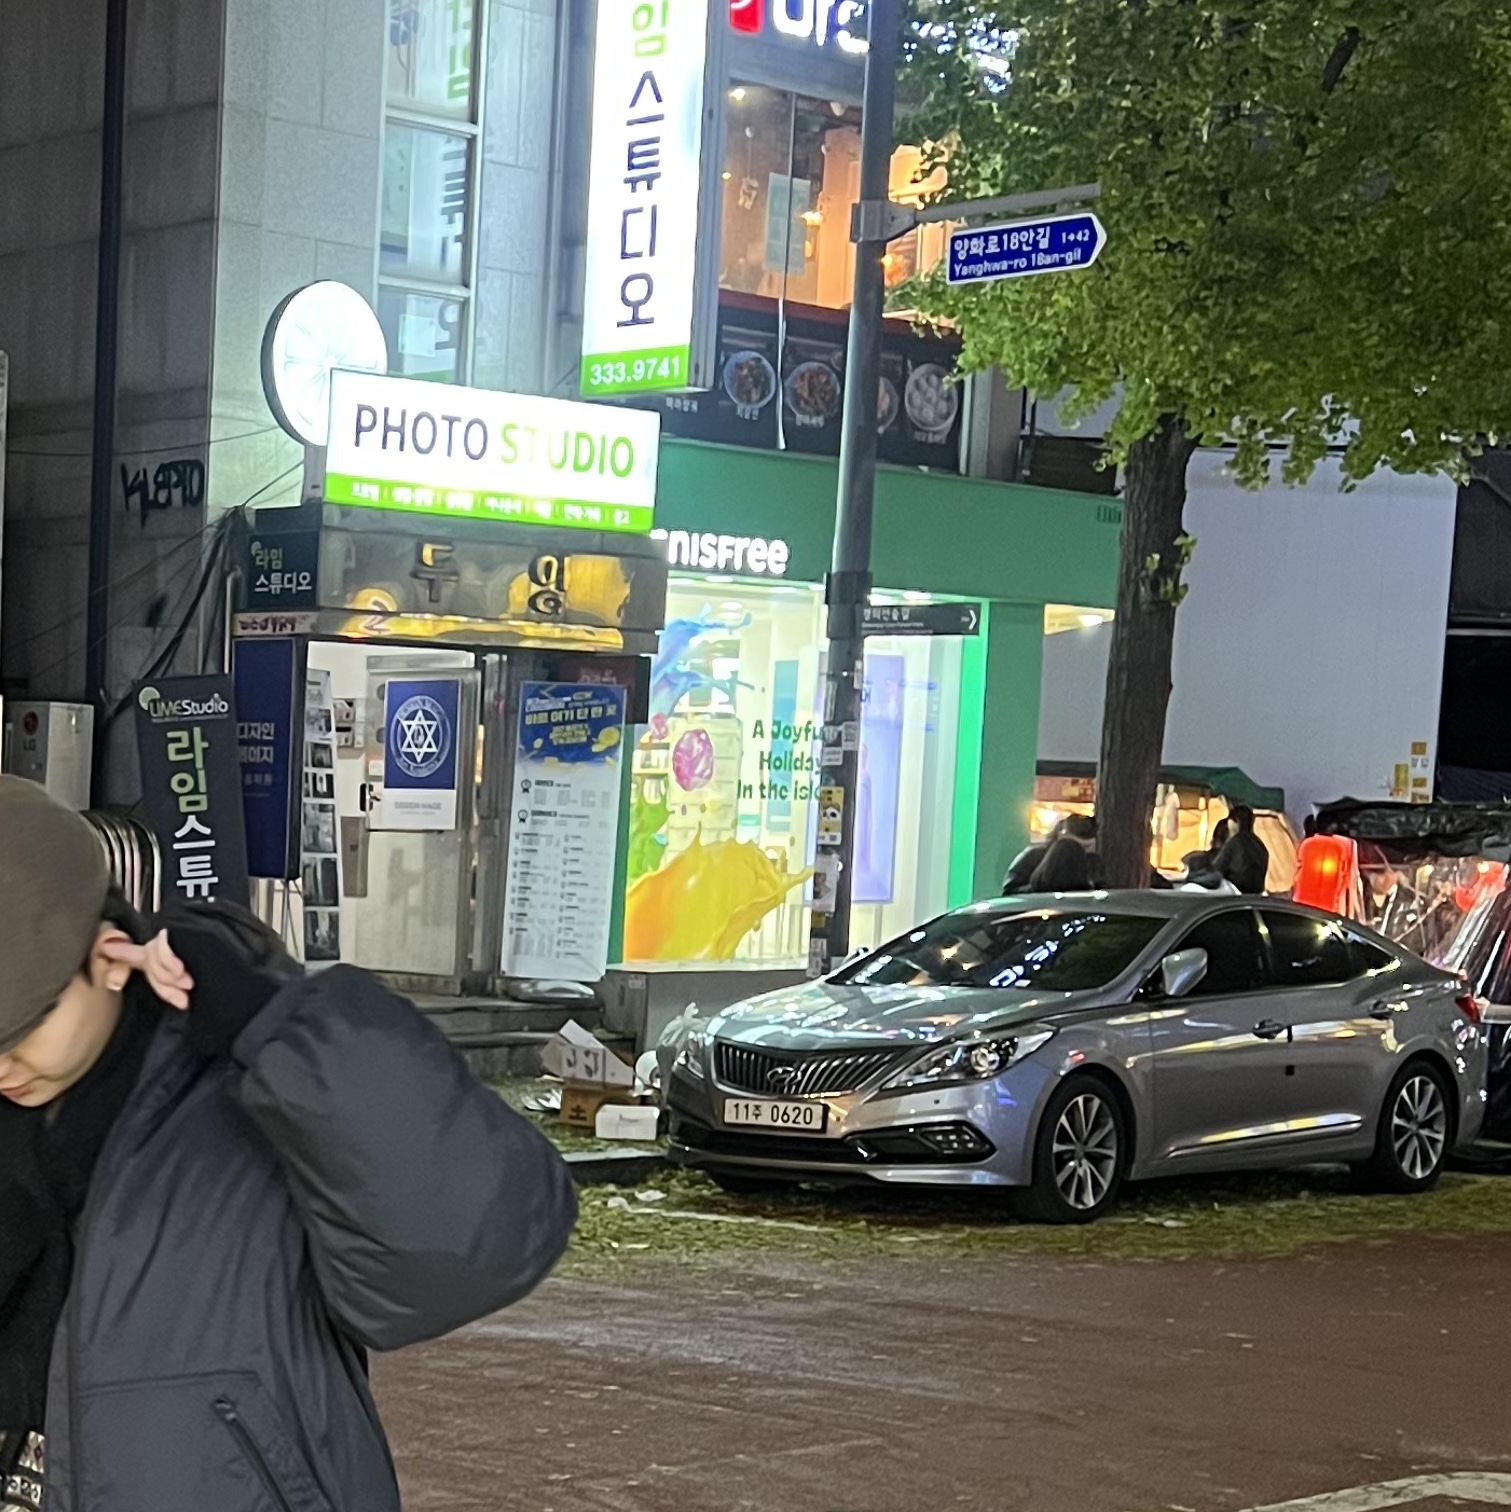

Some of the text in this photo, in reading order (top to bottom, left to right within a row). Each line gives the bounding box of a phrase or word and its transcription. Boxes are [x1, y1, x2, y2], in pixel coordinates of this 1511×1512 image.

[954, 226, 1051, 261] 양화로18안길
[954, 256, 1028, 277] Yanghwa-ro
[590, 356, 680, 385] 333.9741
[354, 402, 634, 478] PHOTO STUDIO
[254, 547, 283, 571] 라임
[254, 570, 313, 595] 스튜디오
[752, 719, 765, 739] A
[771, 720, 826, 744] Joyfu
[166, 726, 219, 904] 라임스튜
[733, 1102, 813, 1125] 11주 0620
